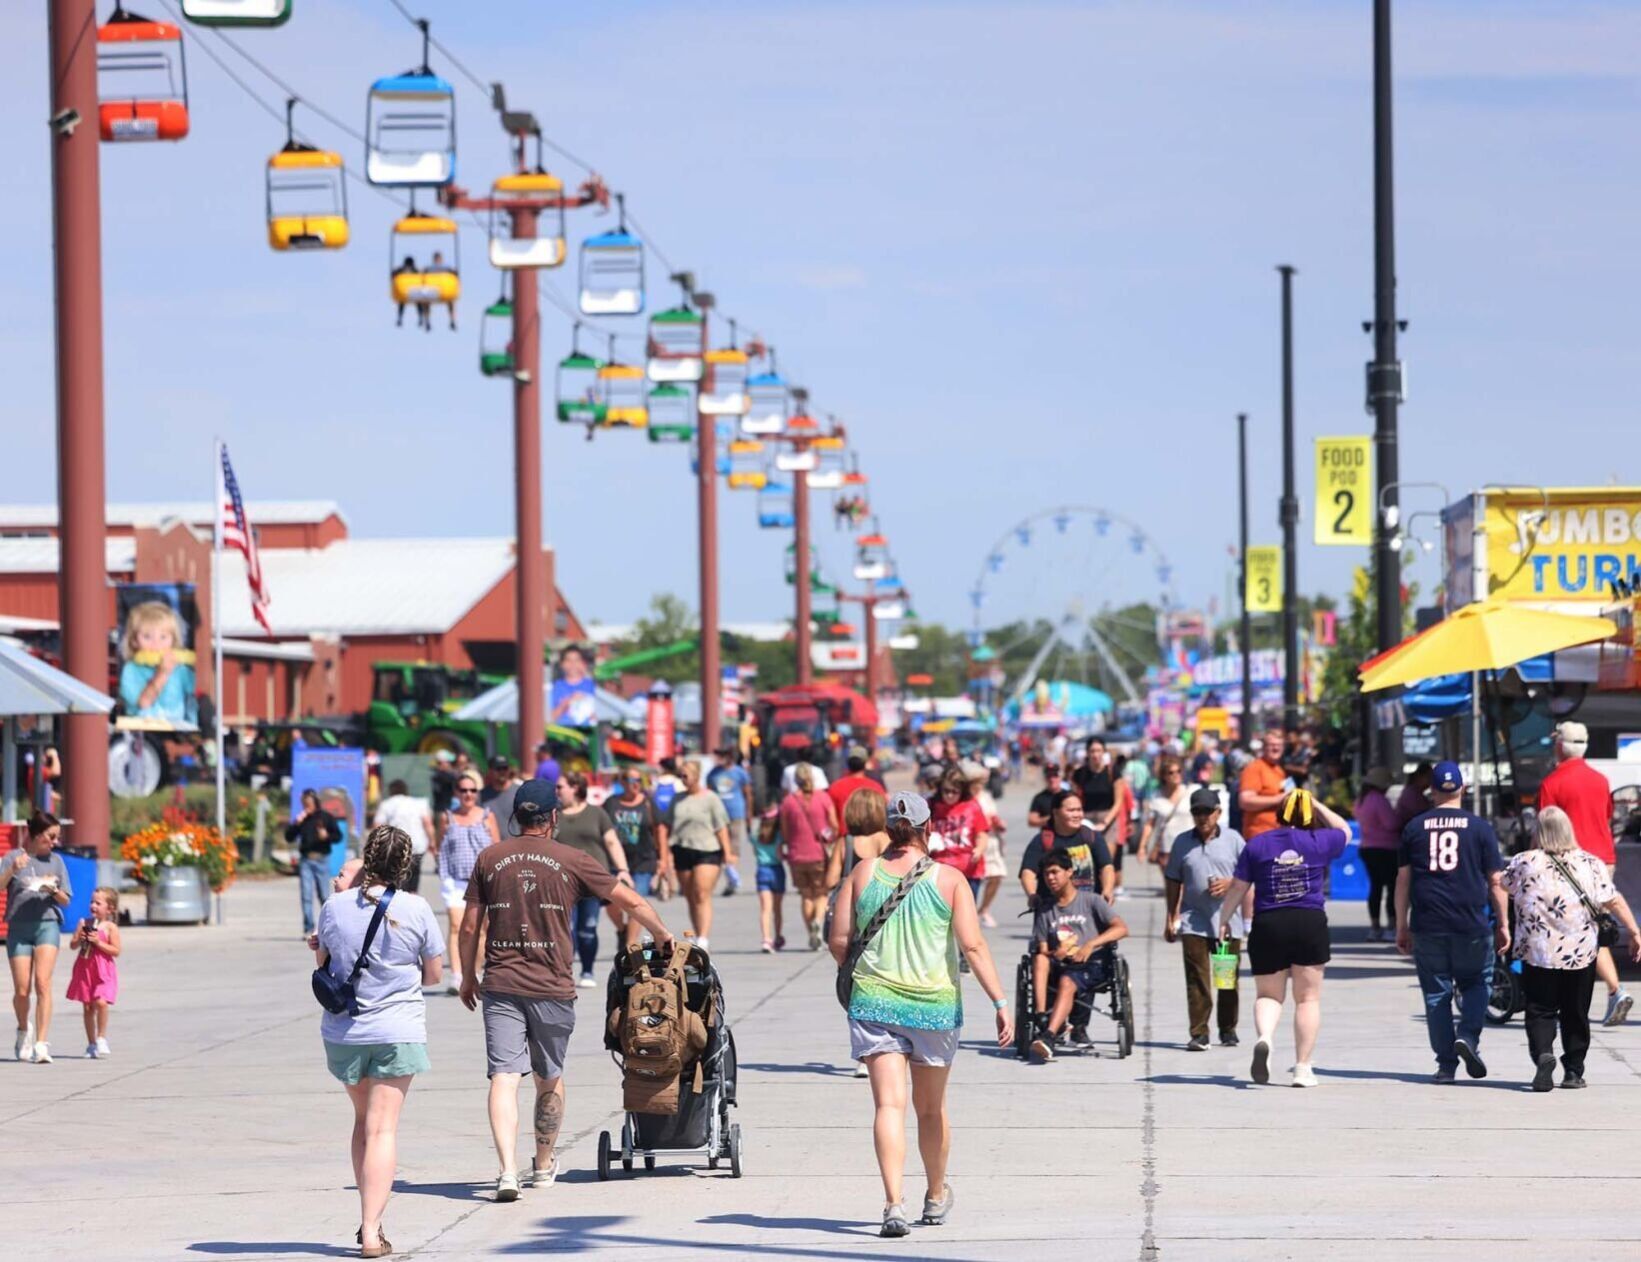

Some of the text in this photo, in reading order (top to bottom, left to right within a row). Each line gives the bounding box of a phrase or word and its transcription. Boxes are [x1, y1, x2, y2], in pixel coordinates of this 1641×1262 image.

[1321, 447, 1364, 467] FOOD
[1333, 490, 1354, 534] 2
[1257, 577, 1271, 604] 3
[1423, 817, 1468, 830] WILLIAMS
[1429, 830, 1459, 871] 18
[495, 854, 561, 871] DIRTY HANDS
[523, 941, 555, 949] MONEY
